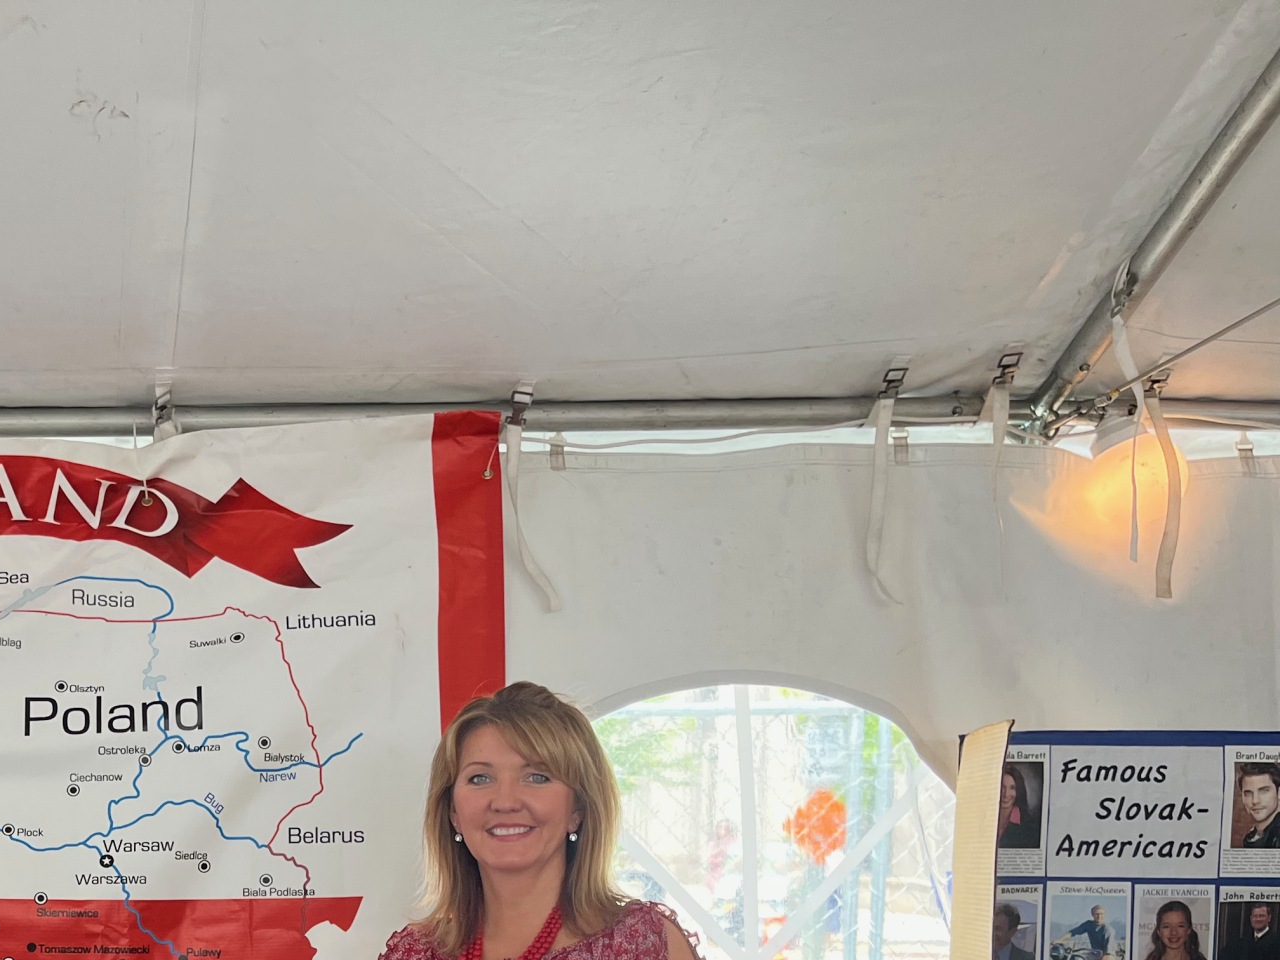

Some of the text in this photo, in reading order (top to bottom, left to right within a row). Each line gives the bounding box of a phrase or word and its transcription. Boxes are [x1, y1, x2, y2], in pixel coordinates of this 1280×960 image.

[72, 589, 134, 608] Russia
[286, 612, 376, 630] Lithuania
[190, 637, 226, 649] Suwalki
[69, 683, 104, 694] Olsztyn
[24, 686, 203, 737] Poland
[98, 745, 146, 755] Ostroleka
[1017, 752, 1046, 760] Barrett
[1236, 752, 1257, 760] Brant
[264, 752, 305, 763] Bialystok
[259, 770, 296, 782] Narew
[1061, 758, 1168, 783] Famous
[69, 772, 123, 782] Ciechanow
[203, 792, 225, 815] Bug
[1095, 797, 1209, 821] Slovak-
[17, 827, 44, 838] Plock
[288, 827, 365, 844] Belarus
[103, 839, 175, 853] Warsaw
[1056, 834, 1208, 858] Americans
[175, 850, 208, 861] Siedlce
[75, 873, 147, 885] Warszawa
[242, 887, 267, 896] Biala
[1142, 888, 1208, 897] JACKIE EVANCHO
[1223, 892, 1244, 901] John
